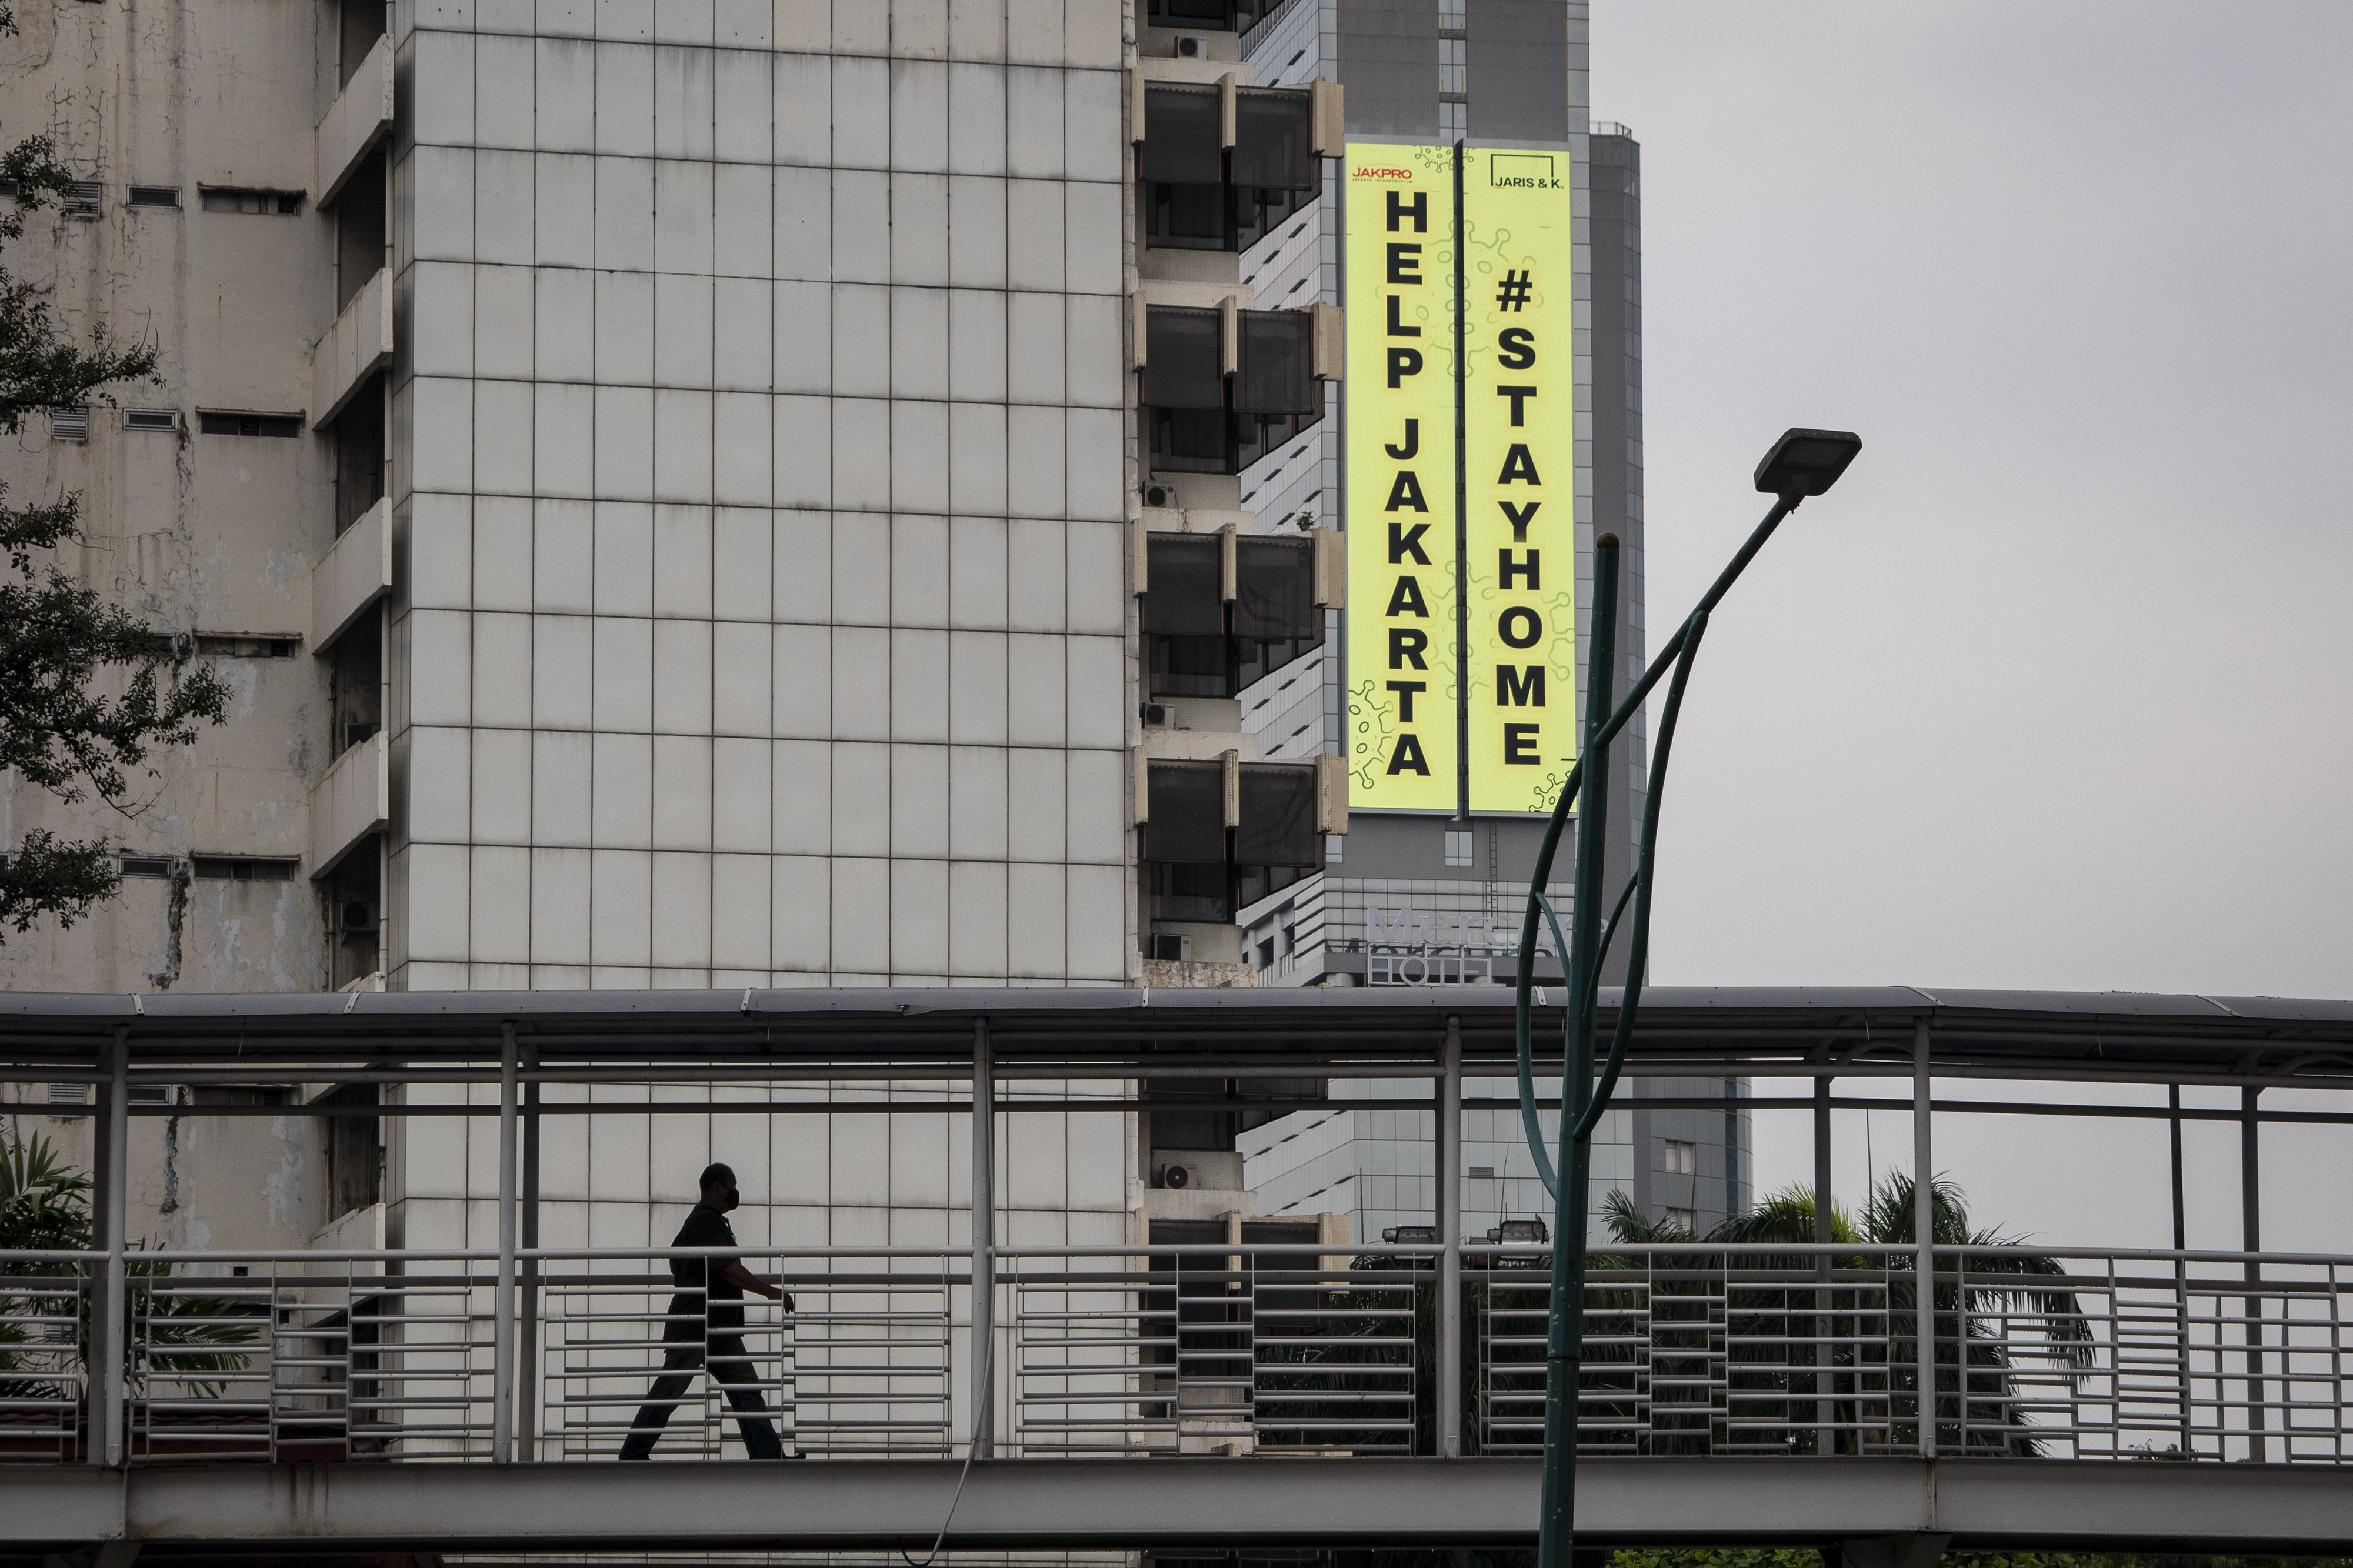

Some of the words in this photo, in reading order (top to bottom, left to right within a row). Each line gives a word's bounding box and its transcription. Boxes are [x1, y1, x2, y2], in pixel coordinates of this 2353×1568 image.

[1352, 167, 1412, 179] JAKPRO
[1495, 176, 1534, 188] JARIS
[1538, 178, 1547, 188] &
[1386, 190, 1428, 389] HELP
[1496, 269, 1546, 765] #STAYHOME
[1384, 418, 1432, 776] JAKARTA
[1367, 906, 1611, 947] Mercur
[1368, 956, 1506, 987] HOTEL
